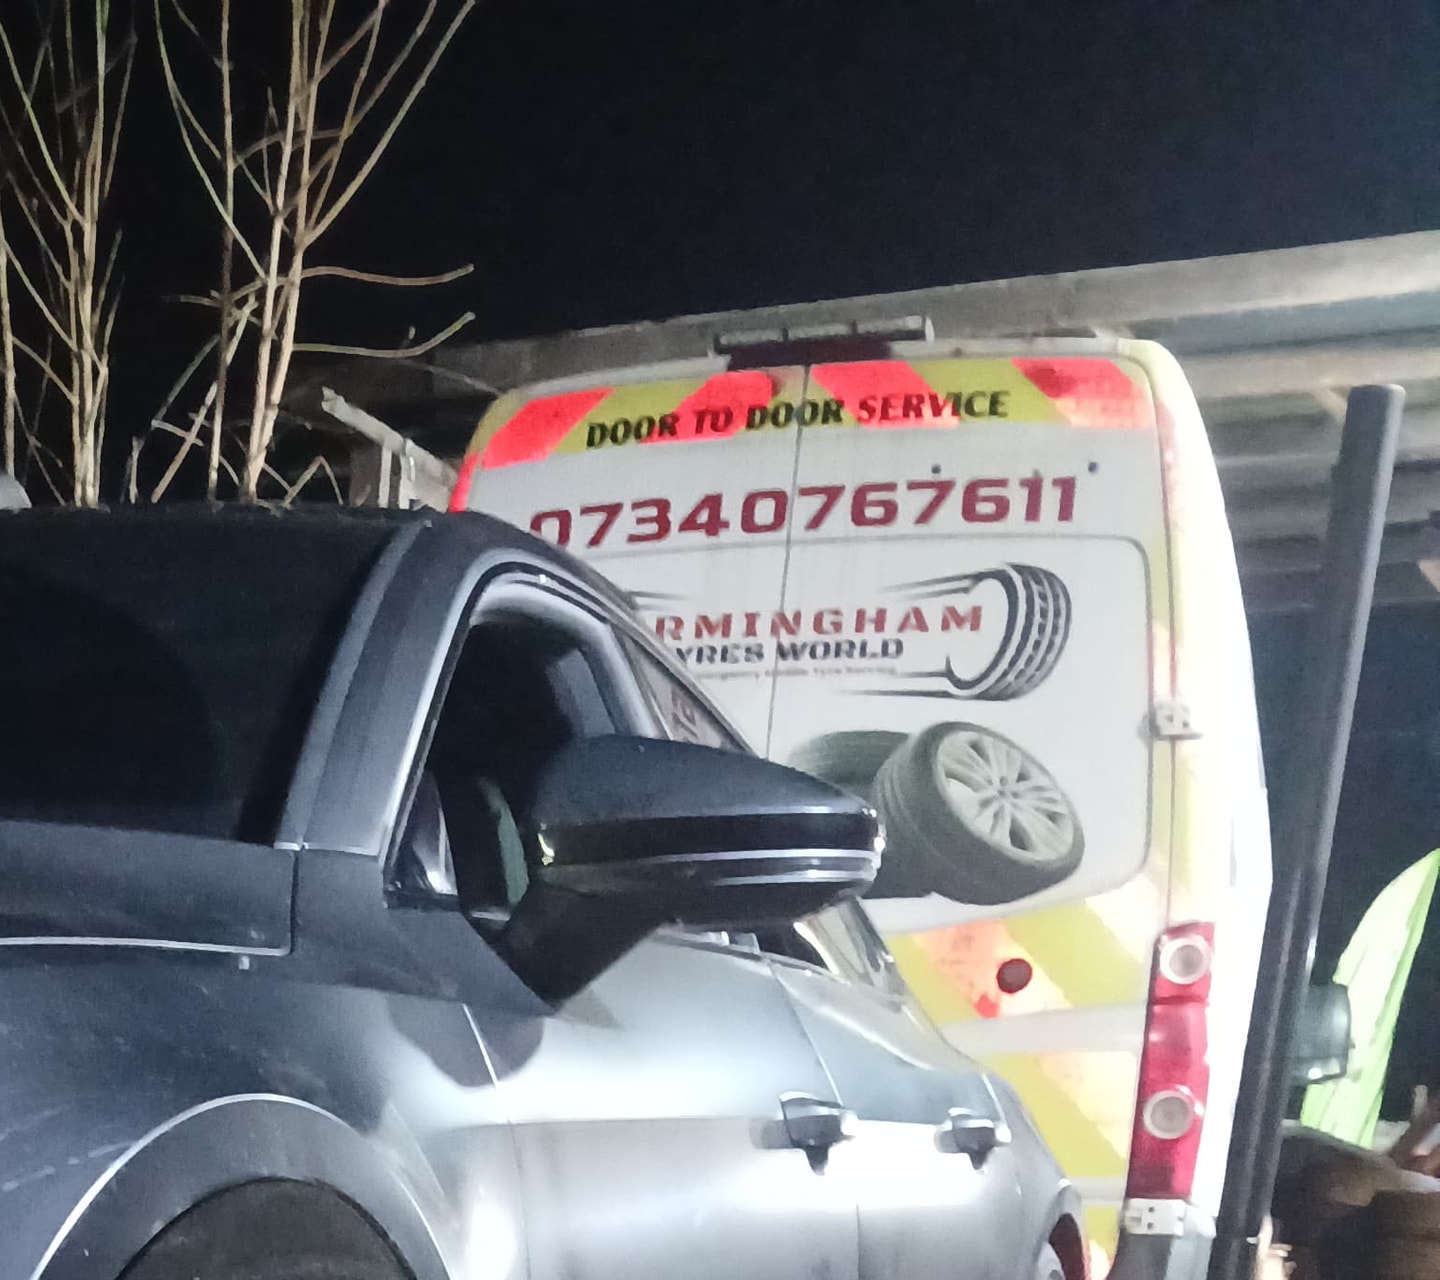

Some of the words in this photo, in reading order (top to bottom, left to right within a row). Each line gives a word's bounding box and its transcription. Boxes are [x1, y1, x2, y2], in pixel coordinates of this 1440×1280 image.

[586, 409, 680, 449] DOOR
[694, 406, 734, 434] TO
[746, 397, 844, 430] DOOR
[859, 390, 1011, 422] SERVICE
[529, 475, 1076, 549] 07340767611
[654, 604, 983, 641] RMINGHAM
[674, 642, 765, 665] YRES
[774, 637, 905, 663] WORLD
